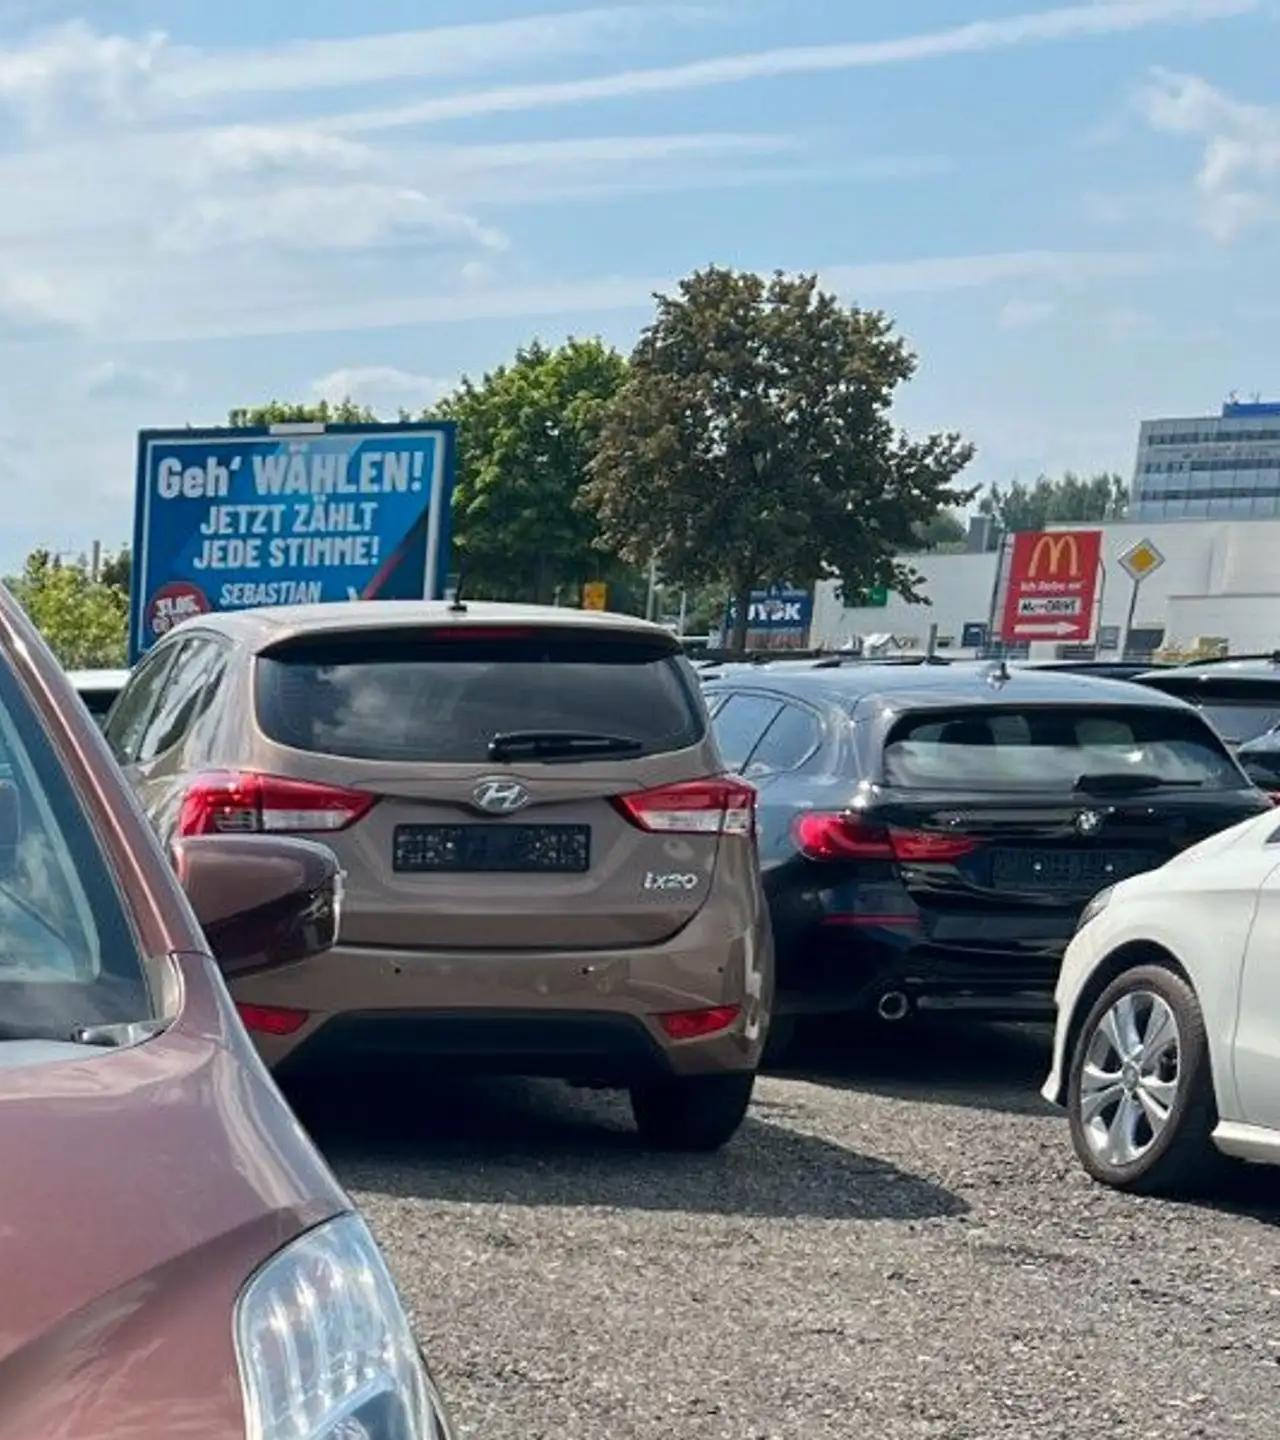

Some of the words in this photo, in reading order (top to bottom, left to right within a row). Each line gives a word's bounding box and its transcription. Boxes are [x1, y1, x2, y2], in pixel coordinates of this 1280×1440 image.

[252, 443, 425, 496] WÄHLEN!
[200, 504, 286, 535] JETZT
[291, 494, 379, 533] ZÄHLT
[193, 538, 264, 569] JEDE
[269, 535, 380, 567] STIMME!
[219, 580, 323, 608] SEBASTIAN
